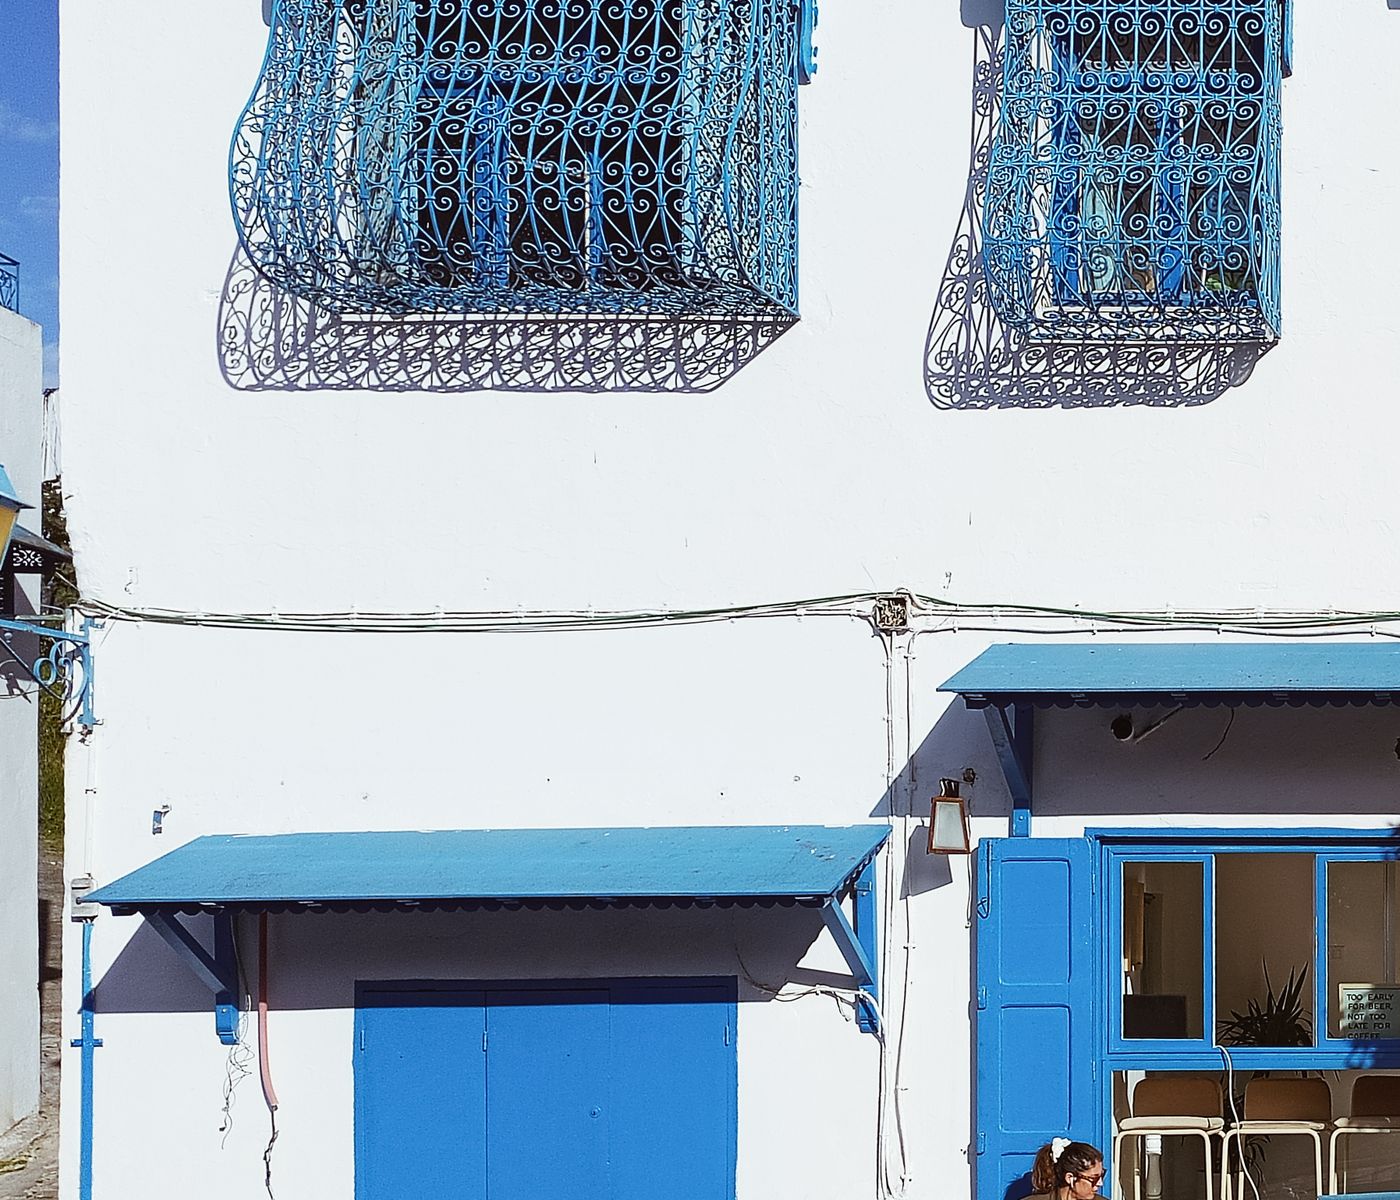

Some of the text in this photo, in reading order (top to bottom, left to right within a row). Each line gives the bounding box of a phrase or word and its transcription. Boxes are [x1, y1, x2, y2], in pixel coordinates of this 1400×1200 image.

[1368, 1003, 1393, 1011] BEER,
[1348, 1022, 1391, 1030] LATE FOR
